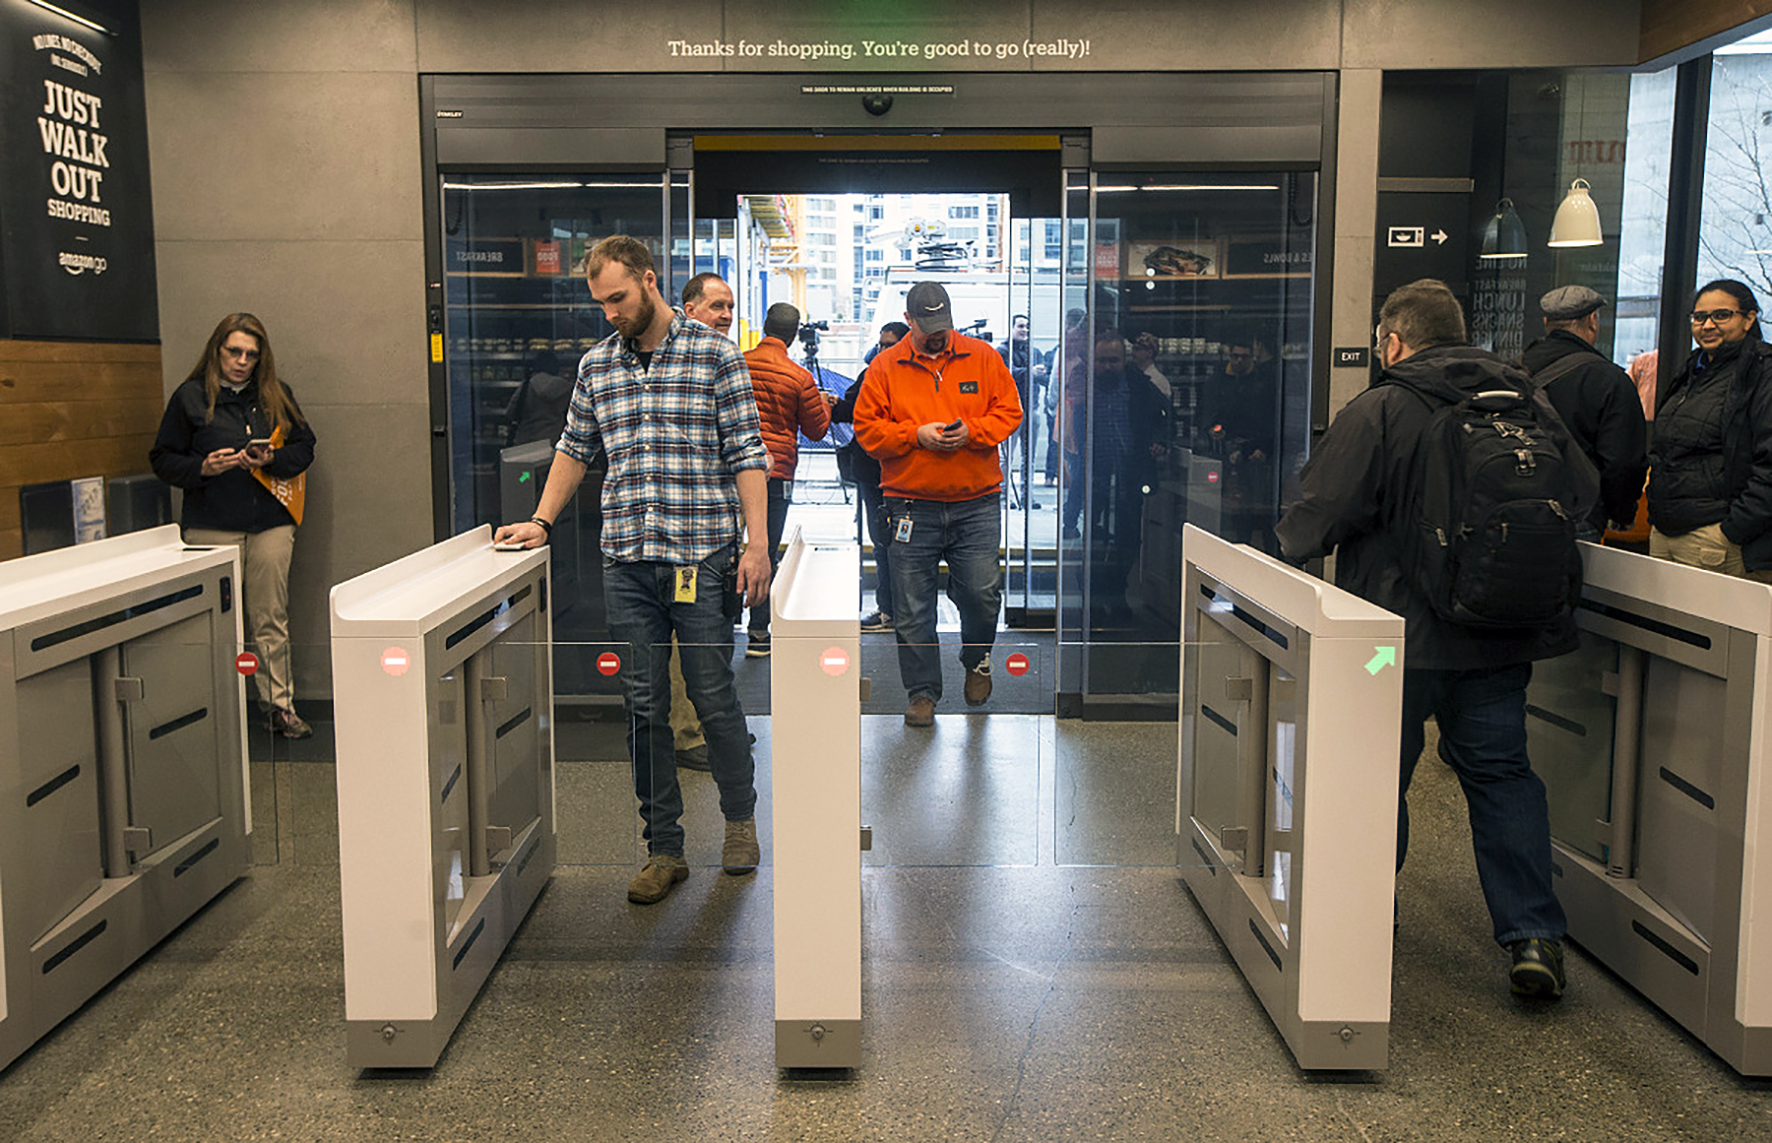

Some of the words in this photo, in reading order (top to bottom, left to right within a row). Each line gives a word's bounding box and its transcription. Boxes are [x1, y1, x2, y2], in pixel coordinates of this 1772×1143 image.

[668, 40, 735, 56] Thanks
[738, 40, 764, 56] for
[768, 40, 857, 60] shopping.
[862, 41, 919, 56] You're
[924, 40, 970, 59] good
[973, 42, 992, 56] to
[995, 43, 1019, 59] go
[1022, 39, 1091, 59] (really)!
[44, 80, 102, 129] JUST
[37, 117, 110, 168] WALK
[52, 161, 103, 203] OUT
[47, 198, 111, 226] SHOPPING
[59, 252, 94, 269] amazon
[1341, 351, 1361, 361] EXIT
